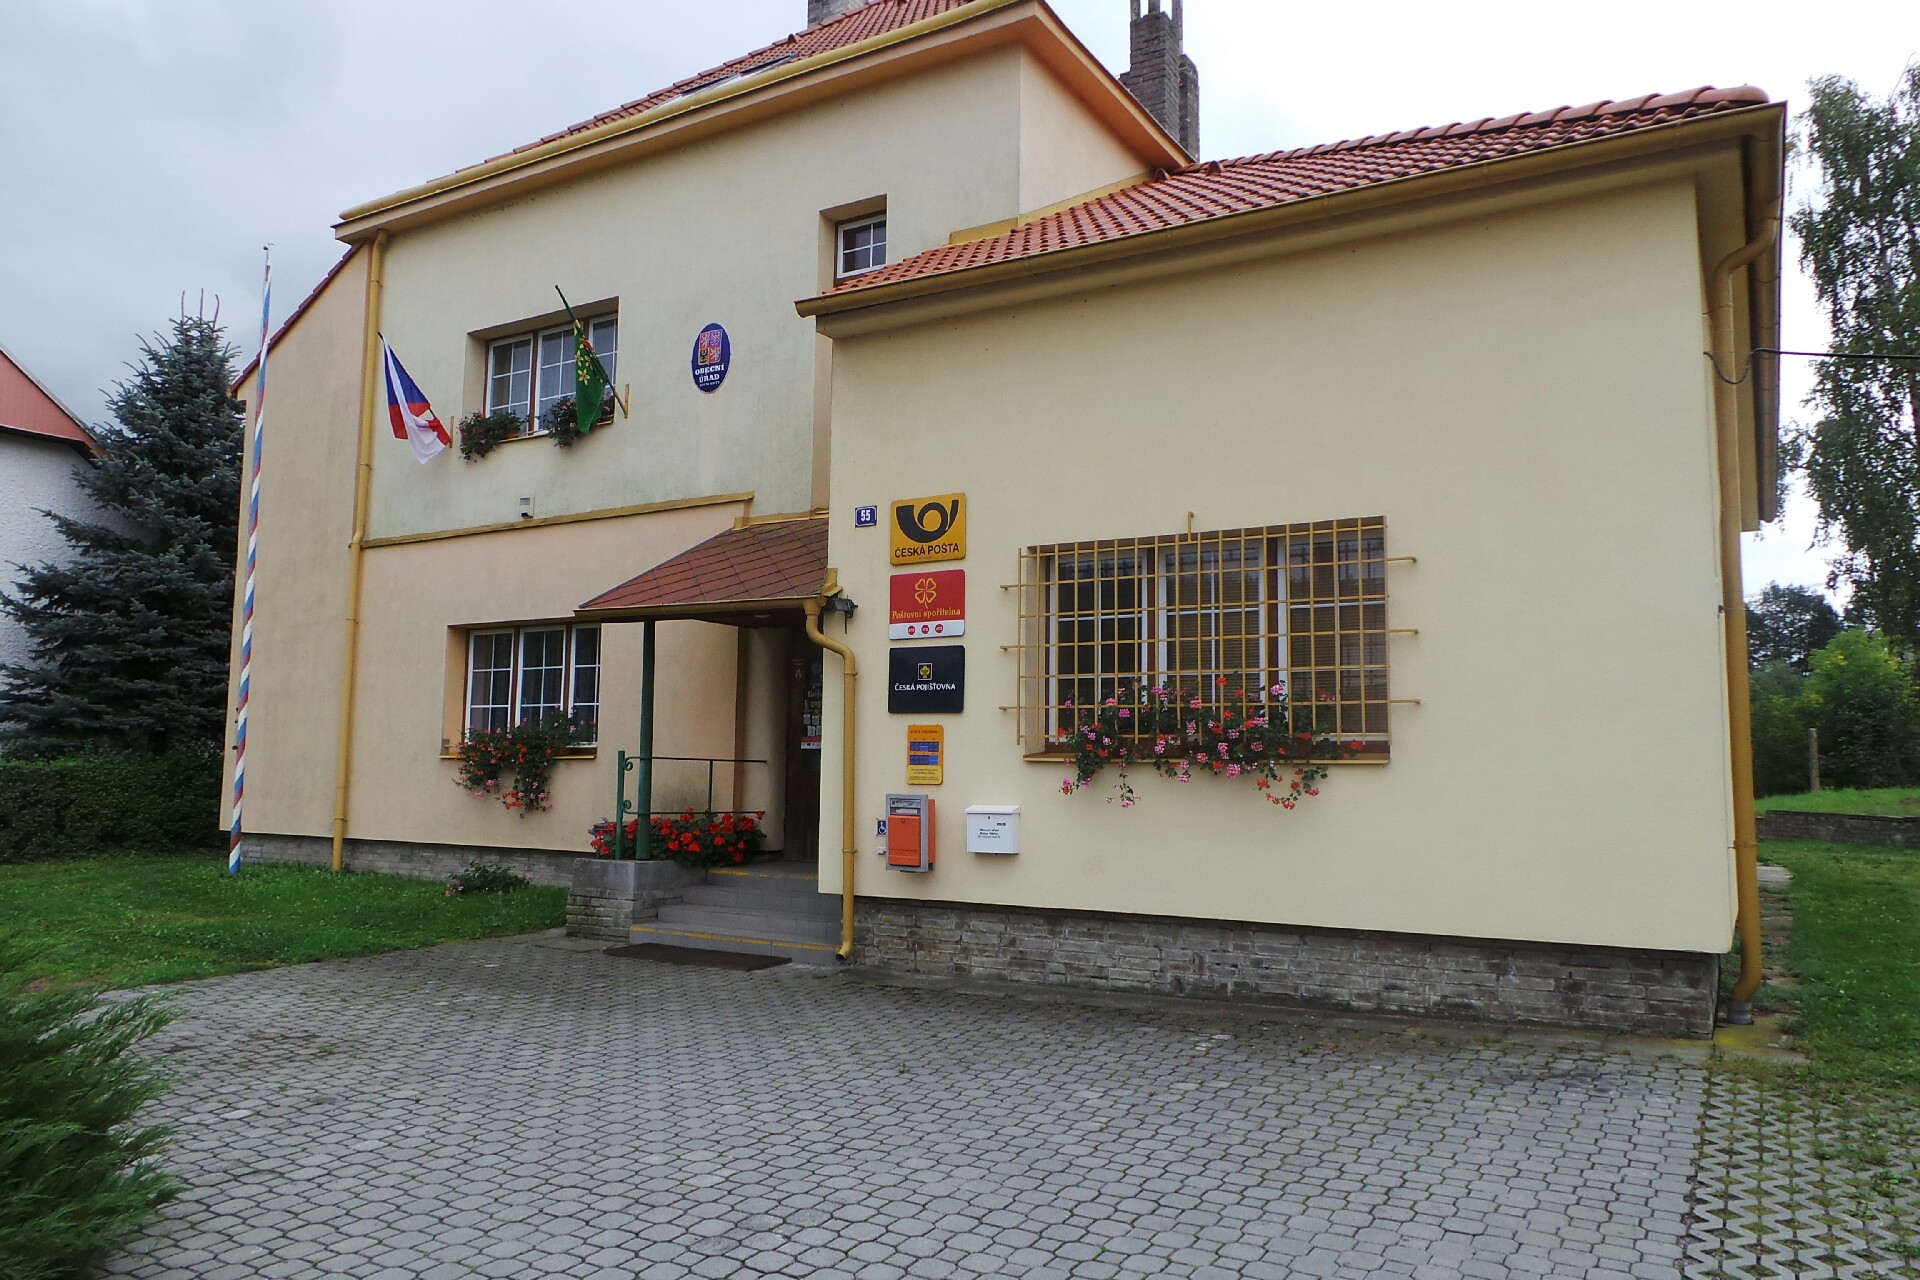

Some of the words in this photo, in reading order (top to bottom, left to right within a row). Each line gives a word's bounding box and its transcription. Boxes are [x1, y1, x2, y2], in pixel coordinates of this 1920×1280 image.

[695, 363, 725, 376] OBECNÍ
[699, 373, 720, 383] ÚŘAD
[860, 509, 871, 522] 55
[894, 544, 926, 558] ČESKÁ
[927, 542, 960, 555] POŠTA
[892, 609, 922, 620] Poštovní
[923, 606, 961, 618] spořitelna
[894, 682, 916, 691] ČESKÁ
[916, 682, 956, 691] POJIŠŤOVNA
